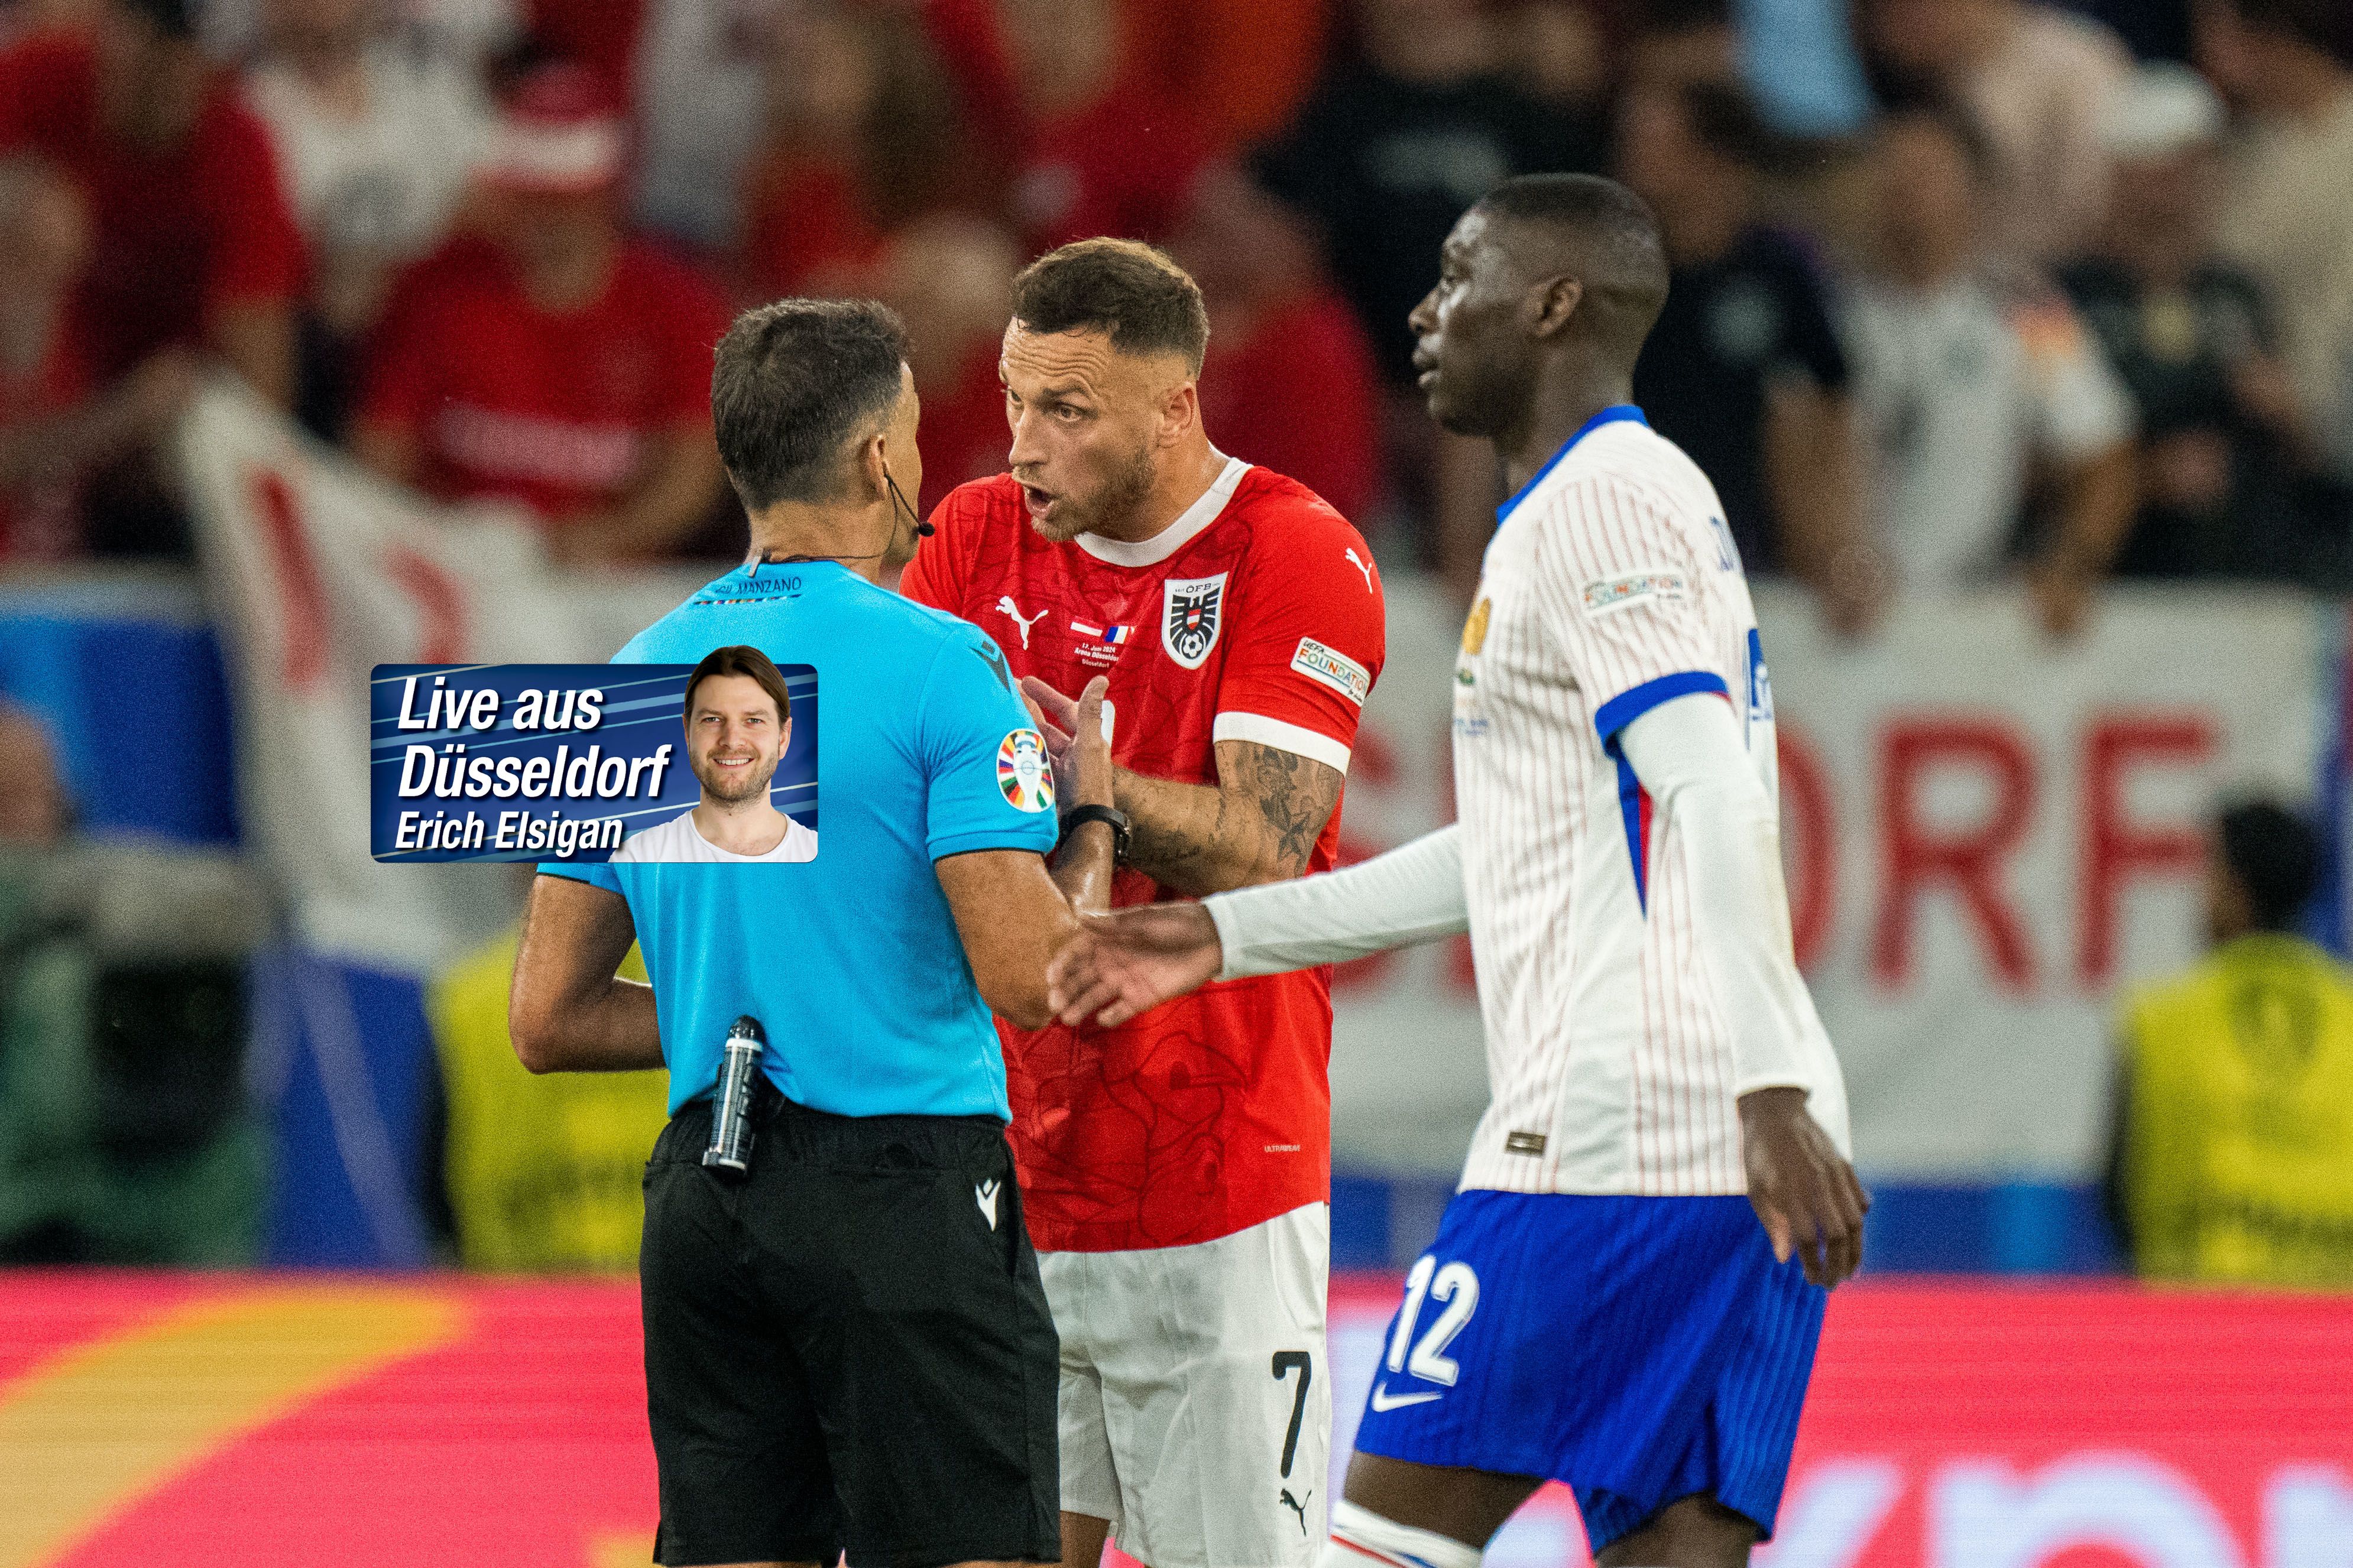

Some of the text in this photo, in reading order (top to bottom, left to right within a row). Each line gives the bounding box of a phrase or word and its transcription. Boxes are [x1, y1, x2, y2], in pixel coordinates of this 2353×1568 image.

[735, 576, 802, 595] MANZANO
[1185, 583, 1211, 593] ÖFB
[1303, 640, 1324, 655] UEFA
[1387, 1254, 1480, 1387] 12
[1272, 1351, 1311, 1479] 7
